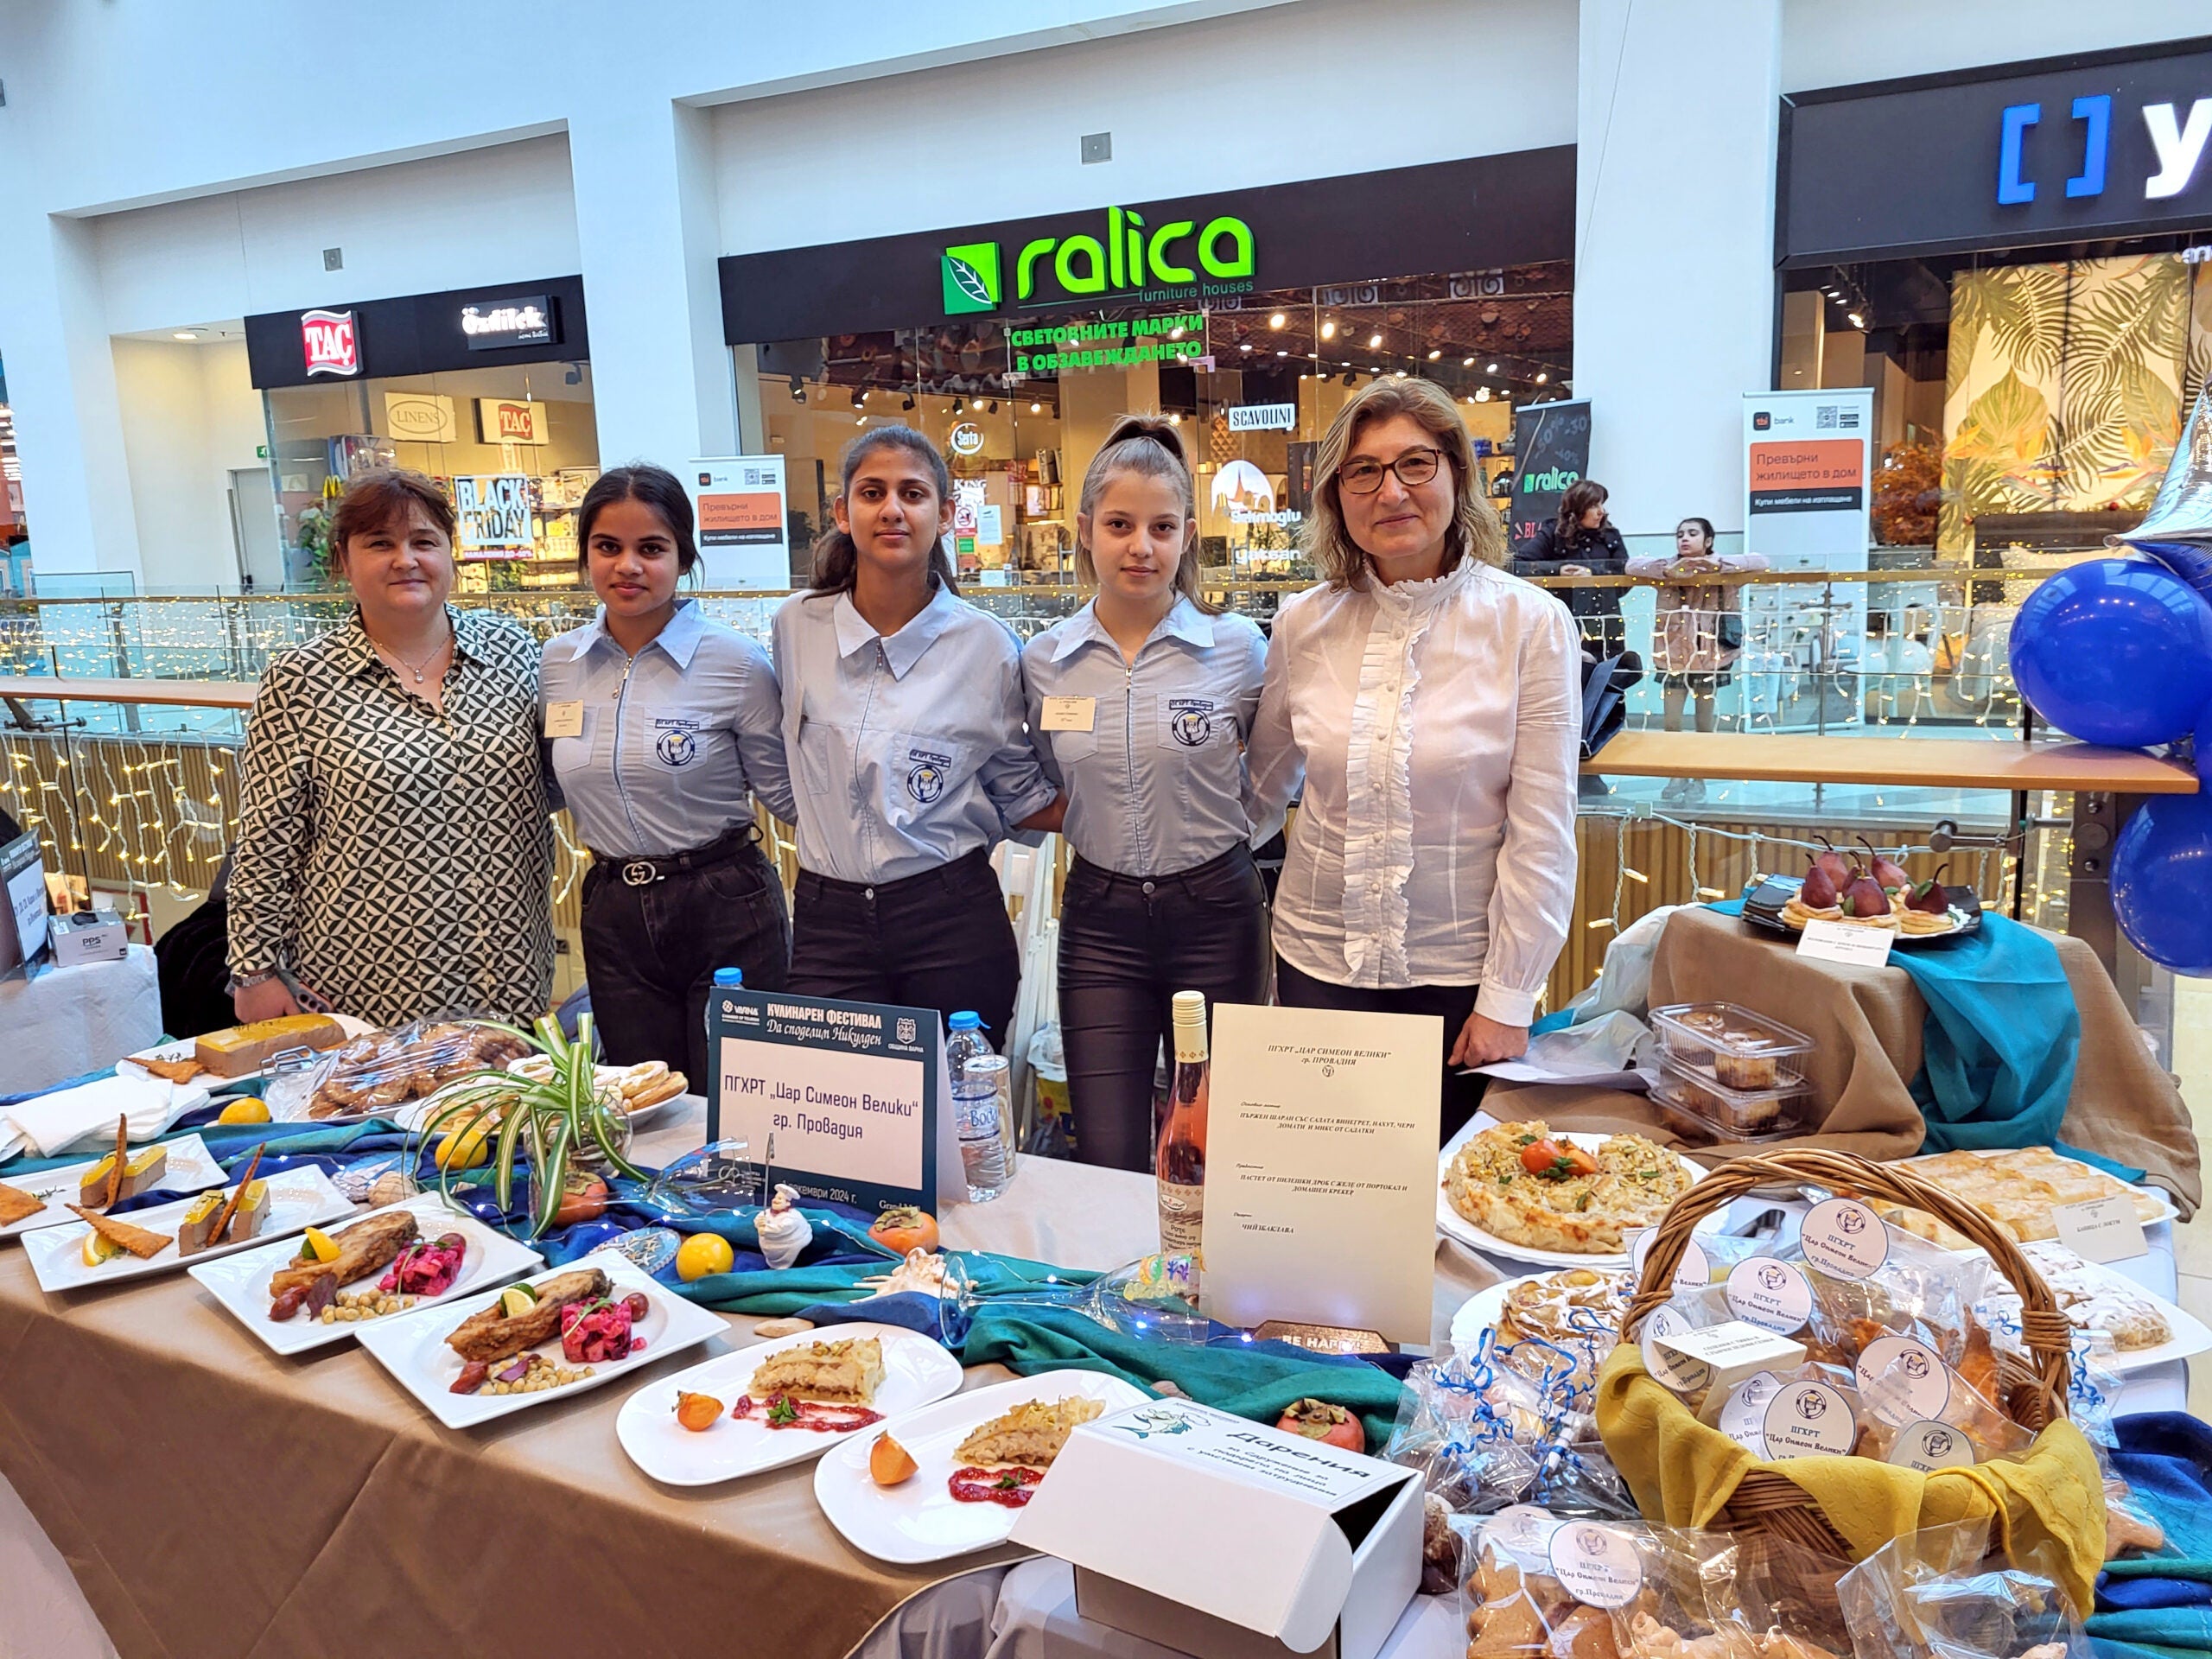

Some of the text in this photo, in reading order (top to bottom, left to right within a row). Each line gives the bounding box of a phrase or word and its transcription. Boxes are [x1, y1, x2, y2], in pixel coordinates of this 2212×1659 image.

[1017, 206, 1255, 300] ralica
[1139, 281, 1254, 302] furniture houses
[1011, 314, 1204, 347] СВЕТОВНИТЕ МАРКИ
[305, 324, 353, 366] TAÇ
[1017, 340, 1202, 371] В ОБЗАВЕЖДАНЕТО
[397, 410, 440, 423] LINENS
[500, 410, 531, 436] TAÇ
[1233, 408, 1291, 427] SCAVOLINI
[1774, 416, 1794, 425] bank
[957, 430, 978, 447] Serta
[1757, 454, 1818, 467] Превърни
[1756, 470, 1821, 481] жилището
[1833, 469, 1857, 479] дом
[459, 478, 525, 511] BLACK
[1754, 499, 1773, 507] Купи
[1774, 497, 1802, 505] мебели
[702, 503, 748, 512] Превърни
[464, 510, 525, 539] FRIDAY
[734, 1005, 759, 1016] VARNA
[767, 1003, 882, 1029] КУЛИНАРЕН ФЕСТИВАЛ
[766, 1019, 882, 1048] Да споделим Никулден
[1268, 1045, 1294, 1053] ПГХРТ
[1317, 1047, 1352, 1057] СИМЕОН
[1312, 1057, 1357, 1065] ПРОВАДИЯ
[725, 1075, 918, 1116] ПГХРТ „Цар Симеон Велики“
[773, 1113, 863, 1140] гр. Провадия
[1277, 1177, 1312, 1185] ПИЛЕШКИ
[1366, 1182, 1402, 1191] ПОРТОКАЛ
[1291, 1185, 1355, 1197] ДОМАШЕН КРЕКЕР
[830, 1187, 849, 1203] 2024
[1827, 1234, 1856, 1250] ПГХРТ
[1753, 1292, 1782, 1306] ПГХРТ
[1790, 1426, 1821, 1438] ПГХРТ
[1226, 1432, 1371, 1478] Дарения
[1198, 1450, 1255, 1470] умствени
[1258, 1470, 1338, 1497] затруднения
[1213, 1448, 1274, 1470] подкрепа
[1293, 1474, 1327, 1486] лица
